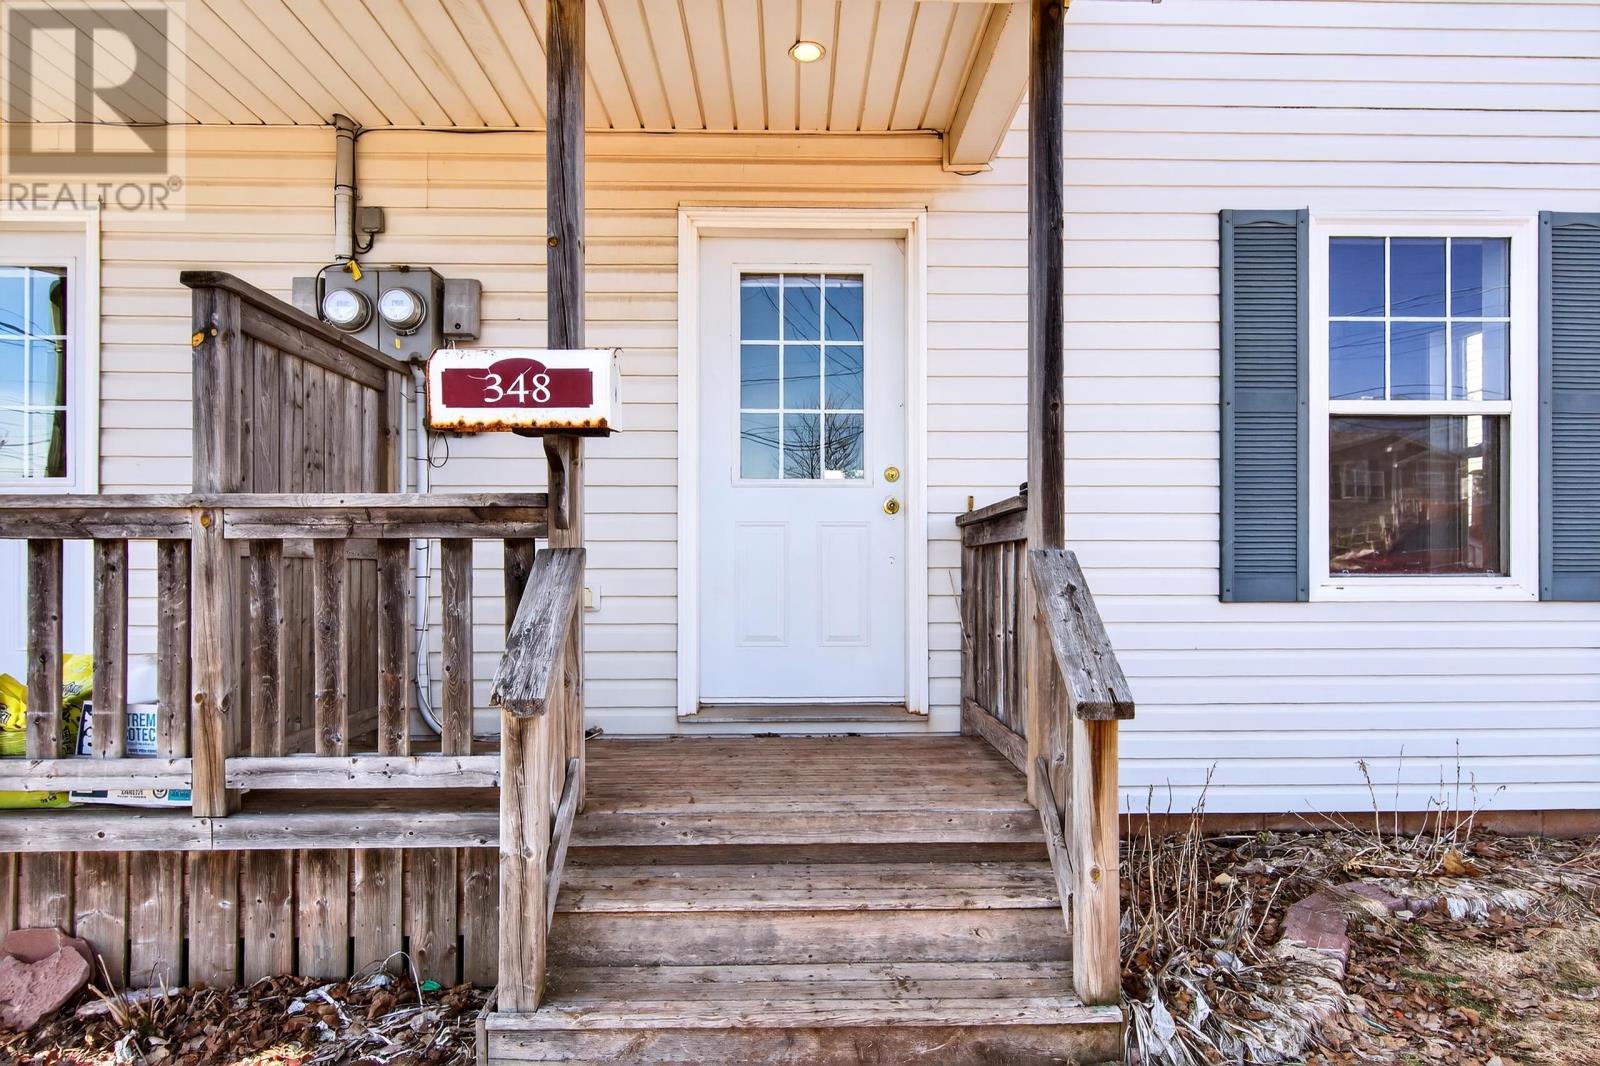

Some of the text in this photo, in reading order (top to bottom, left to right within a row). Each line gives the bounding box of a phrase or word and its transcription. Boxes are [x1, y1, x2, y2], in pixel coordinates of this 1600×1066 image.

[483, 373, 551, 404] 348
[127, 712, 156, 727] TREM
[127, 728, 156, 742] OTEC
